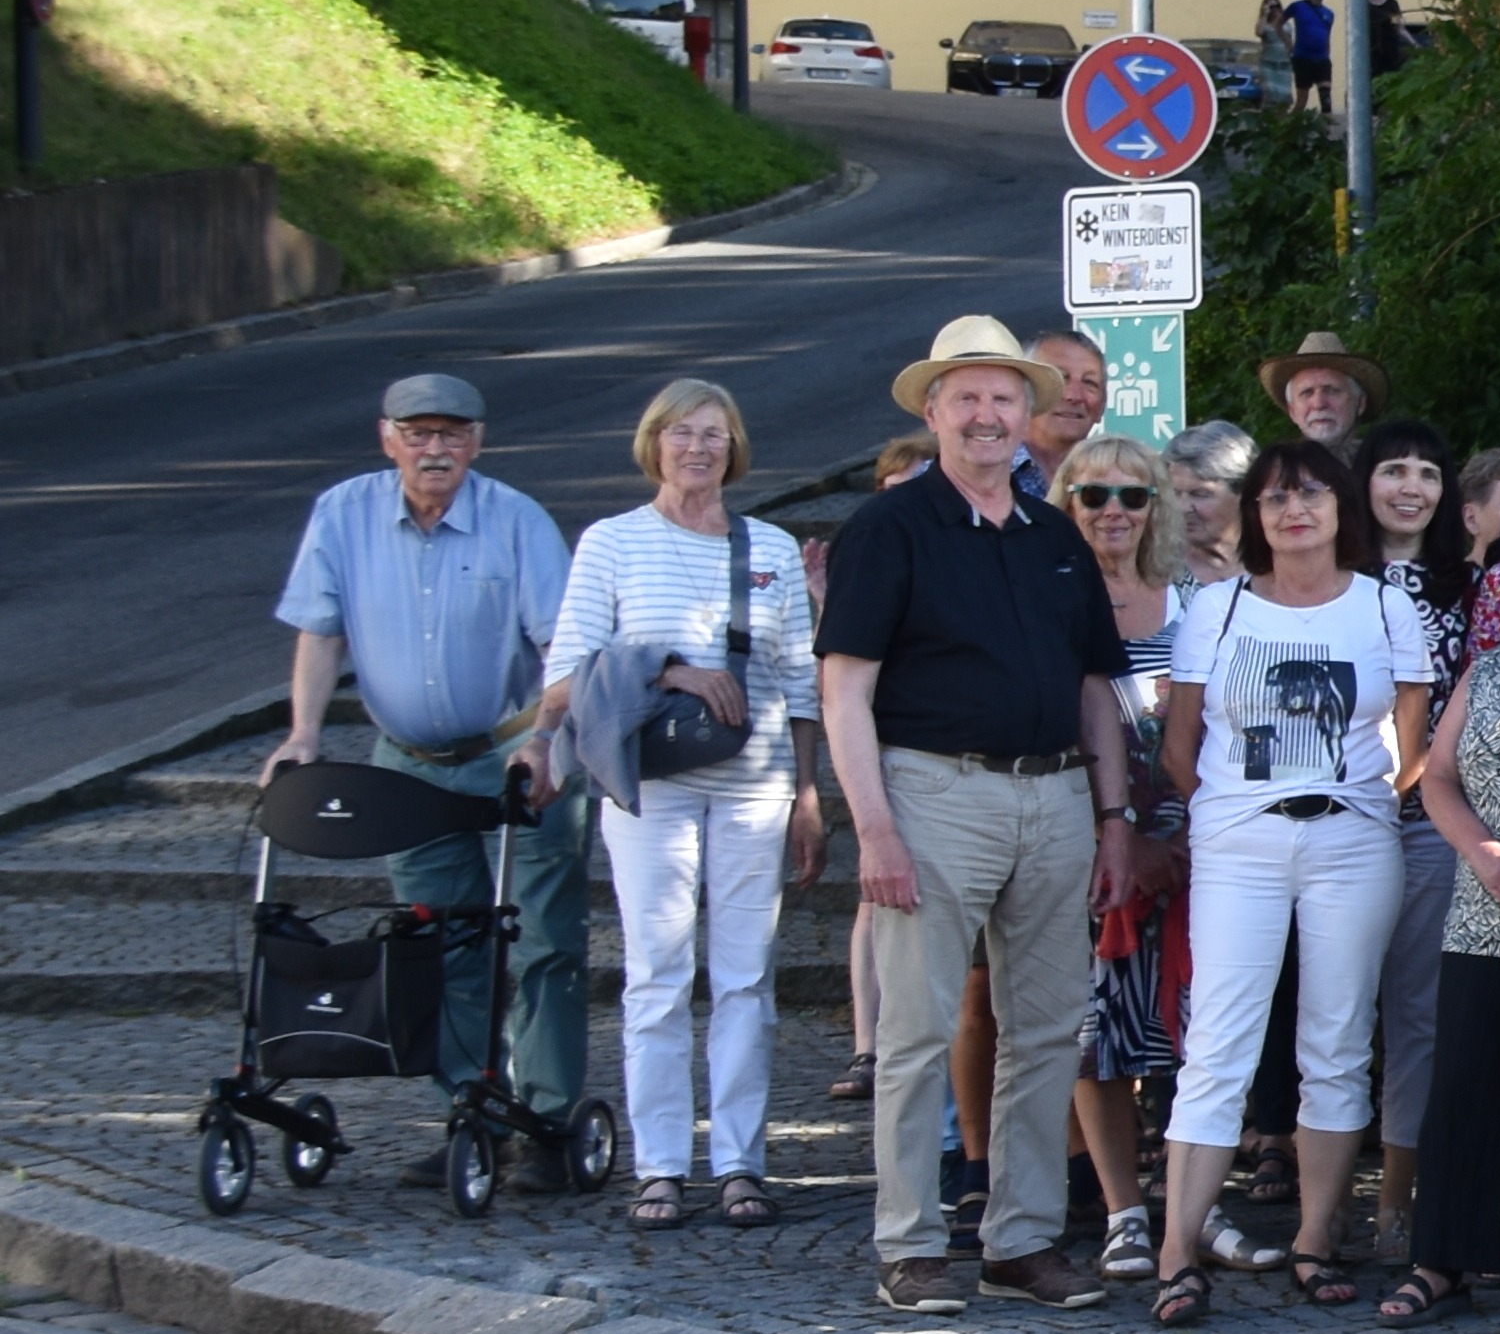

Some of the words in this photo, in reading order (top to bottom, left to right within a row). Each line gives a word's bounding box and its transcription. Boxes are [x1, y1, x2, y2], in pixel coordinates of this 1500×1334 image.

[1102, 202, 1130, 221] KEIN
[1103, 226, 1189, 247] WINTERDIENST
[1154, 255, 1173, 270] auf
